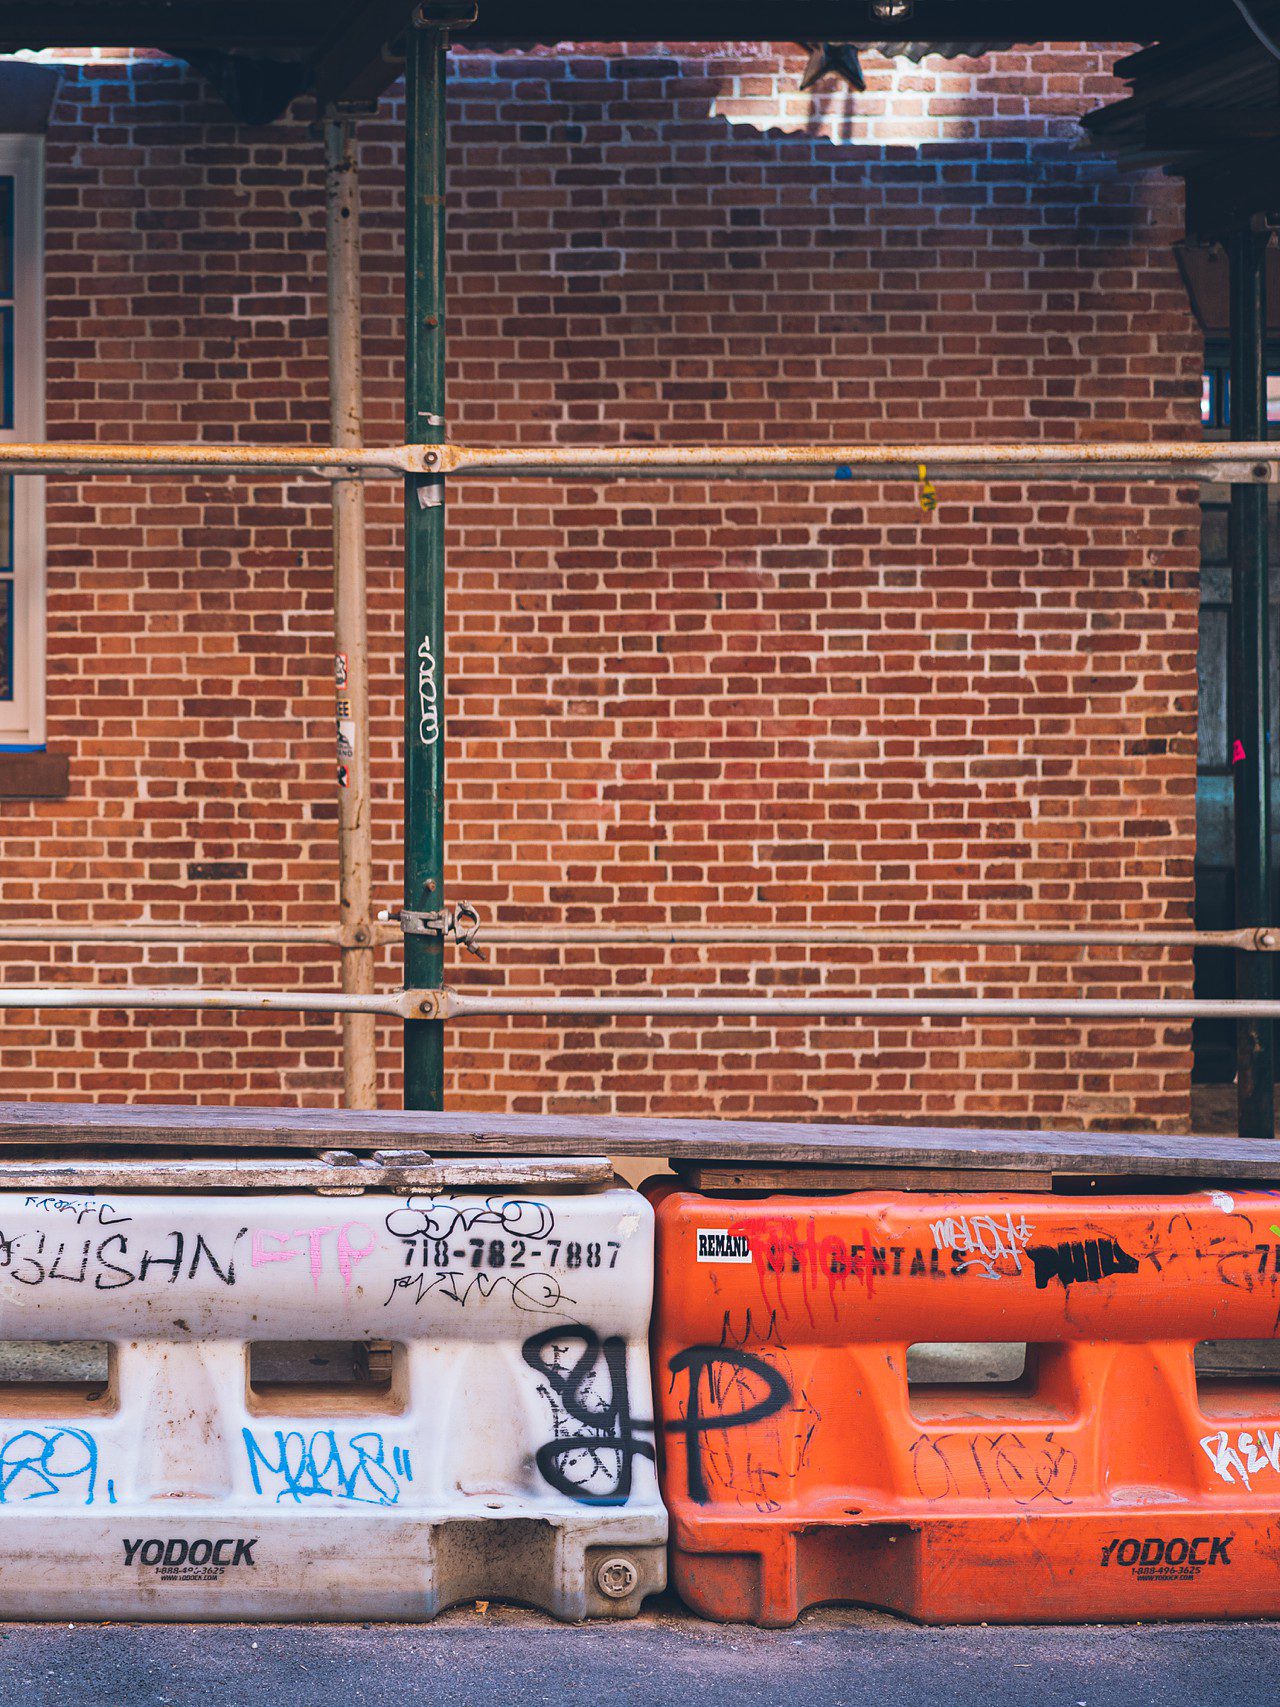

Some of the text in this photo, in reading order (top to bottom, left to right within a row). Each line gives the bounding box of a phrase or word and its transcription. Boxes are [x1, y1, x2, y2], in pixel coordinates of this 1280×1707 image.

[402, 1238, 620, 1269] 718-782-7887
[698, 1234, 750, 1258] REMAND
[122, 1538, 258, 1566] YODOCK
[1100, 1537, 1234, 1567] YODOCK
